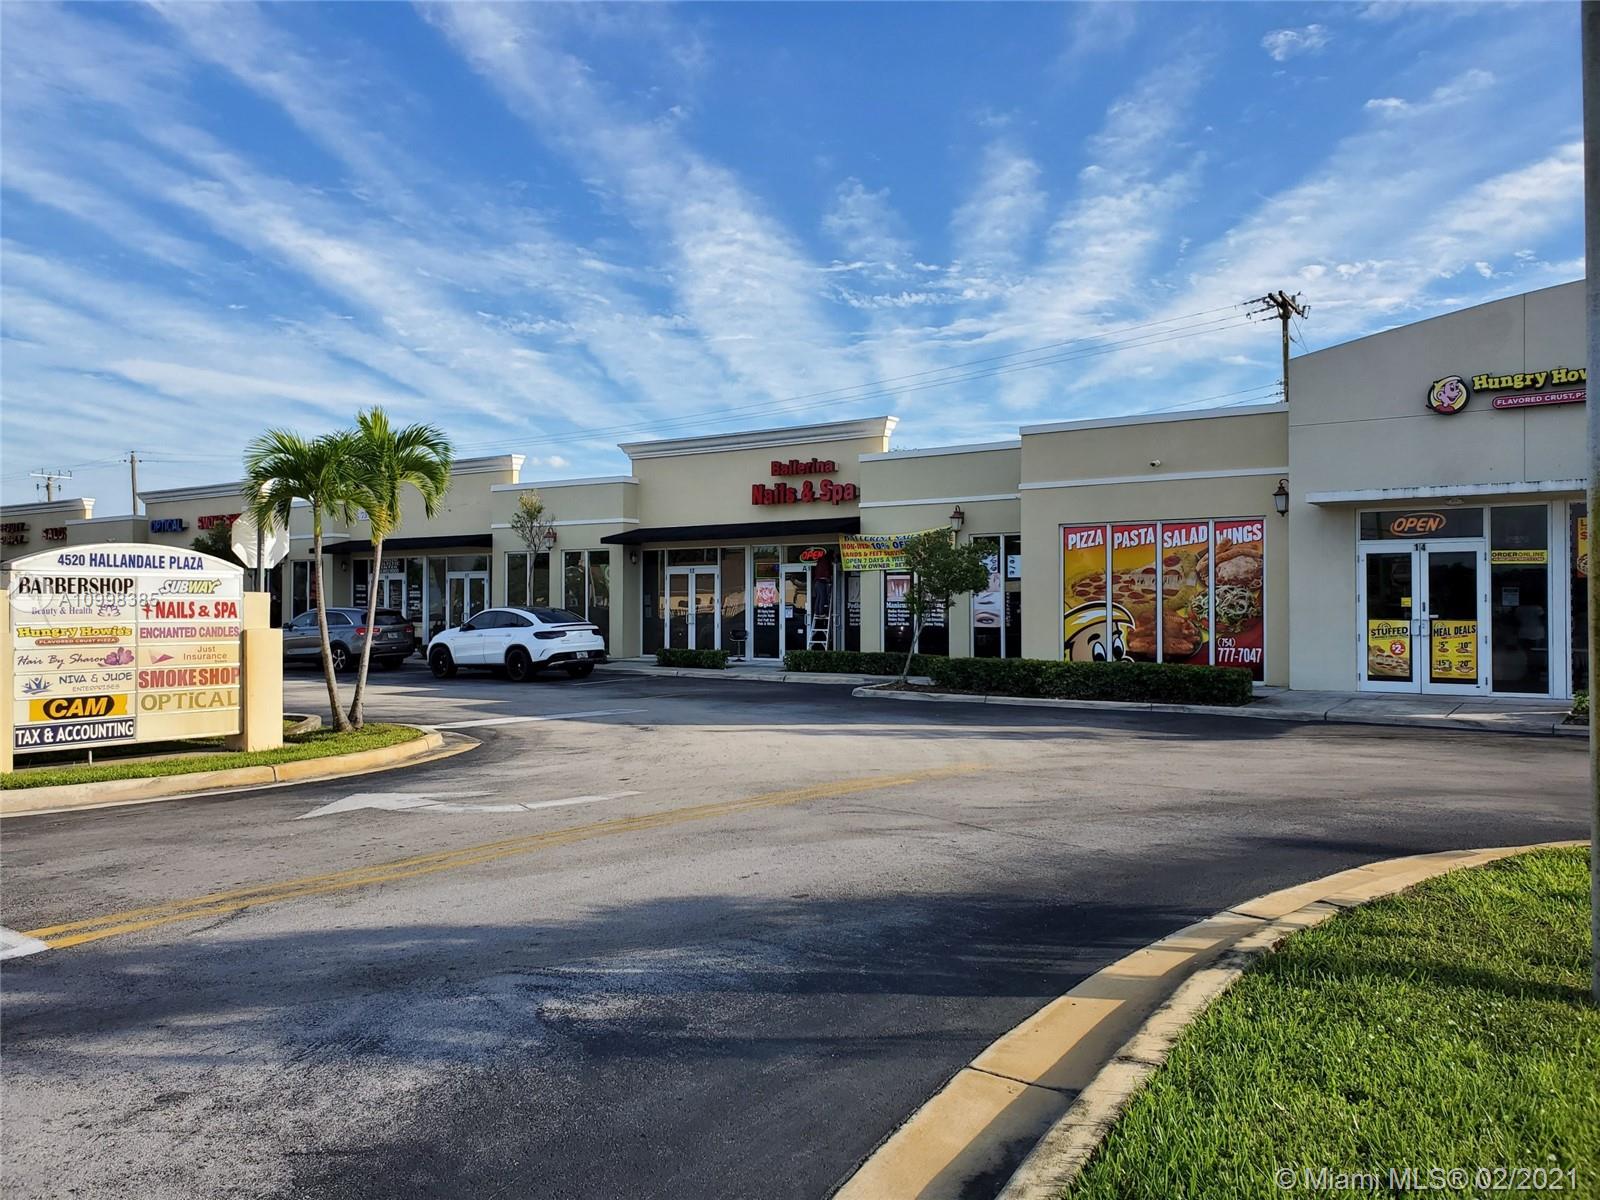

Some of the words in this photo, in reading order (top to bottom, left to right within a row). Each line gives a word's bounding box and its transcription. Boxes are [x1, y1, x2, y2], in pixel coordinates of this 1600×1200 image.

[1473, 371, 1547, 390] Hungry
[1497, 396, 1542, 405] FLAVORED
[771, 458, 836, 476] Ballerina
[752, 483, 797, 505] Nails
[801, 480, 815, 503] &
[820, 479, 856, 505] Spa
[151, 518, 183, 533] OPTICAL
[1394, 518, 1440, 531] OPEN
[1068, 529, 1103, 550] PIZZA
[1113, 527, 1155, 549] PASTA
[1163, 526, 1208, 549] SALAD
[58, 554, 85, 566] 4520
[90, 553, 165, 569] HALLANDALE
[169, 554, 203, 570] PLAZA
[801, 550, 824, 560] OPEN
[19, 577, 134, 594] BARBERSHOP
[159, 579, 222, 594] SUBWAY
[156, 601, 195, 619] NAILS
[198, 605, 210, 617] &
[214, 601, 237, 619] SPA
[17, 627, 78, 638] Hungry
[80, 626, 133, 636] Howie's
[140, 627, 196, 639] ENCHANTED
[199, 626, 240, 637] CANDLES
[1370, 626, 1408, 636] STUFFED
[1433, 627, 1451, 637] MEAL
[1455, 625, 1476, 635] DEALS
[1218, 637, 1236, 647] (754)
[17, 656, 43, 665] Hair
[48, 655, 65, 669] By
[69, 654, 106, 664] Sharon
[1217, 648, 1262, 663] 777-7047
[59, 675, 87, 684] NIVA
[91, 674, 98, 682] &
[103, 672, 132, 681] JUDE
[138, 669, 197, 689] SMOKE
[199, 667, 240, 686] SHOP
[49, 697, 108, 718] CAM
[16, 729, 40, 745] TAX
[44, 728, 53, 742] &
[56, 721, 134, 742] ACCOUNTING
